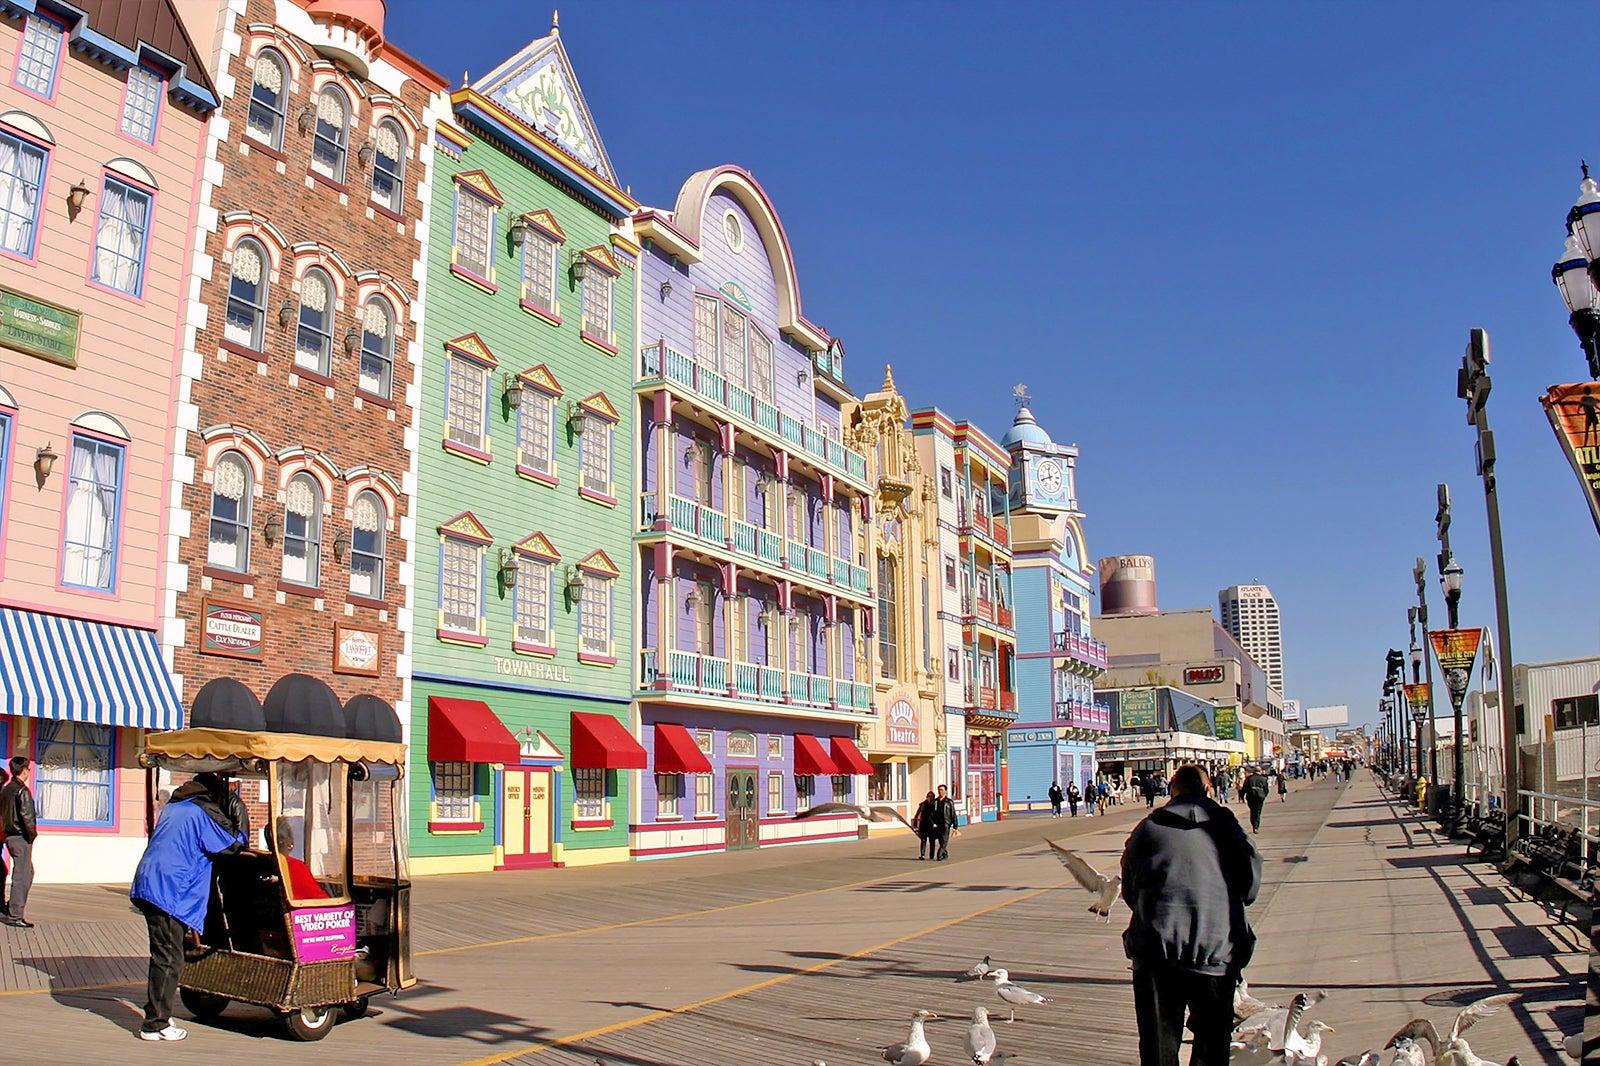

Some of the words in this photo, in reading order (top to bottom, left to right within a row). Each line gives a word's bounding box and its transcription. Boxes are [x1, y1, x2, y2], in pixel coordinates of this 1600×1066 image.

[208, 620, 232, 632] CATTLE
[232, 623, 257, 636] DEALER
[227, 637, 251, 647] NEVADA
[494, 656, 533, 677] TOWN
[536, 663, 570, 682] HALL
[889, 727, 916, 743] Theatre
[294, 914, 313, 924] BEST
[313, 911, 343, 922] VARIETY
[343, 910, 355, 919] OF
[300, 921, 325, 931] VIDEO
[325, 918, 351, 929] POKER
